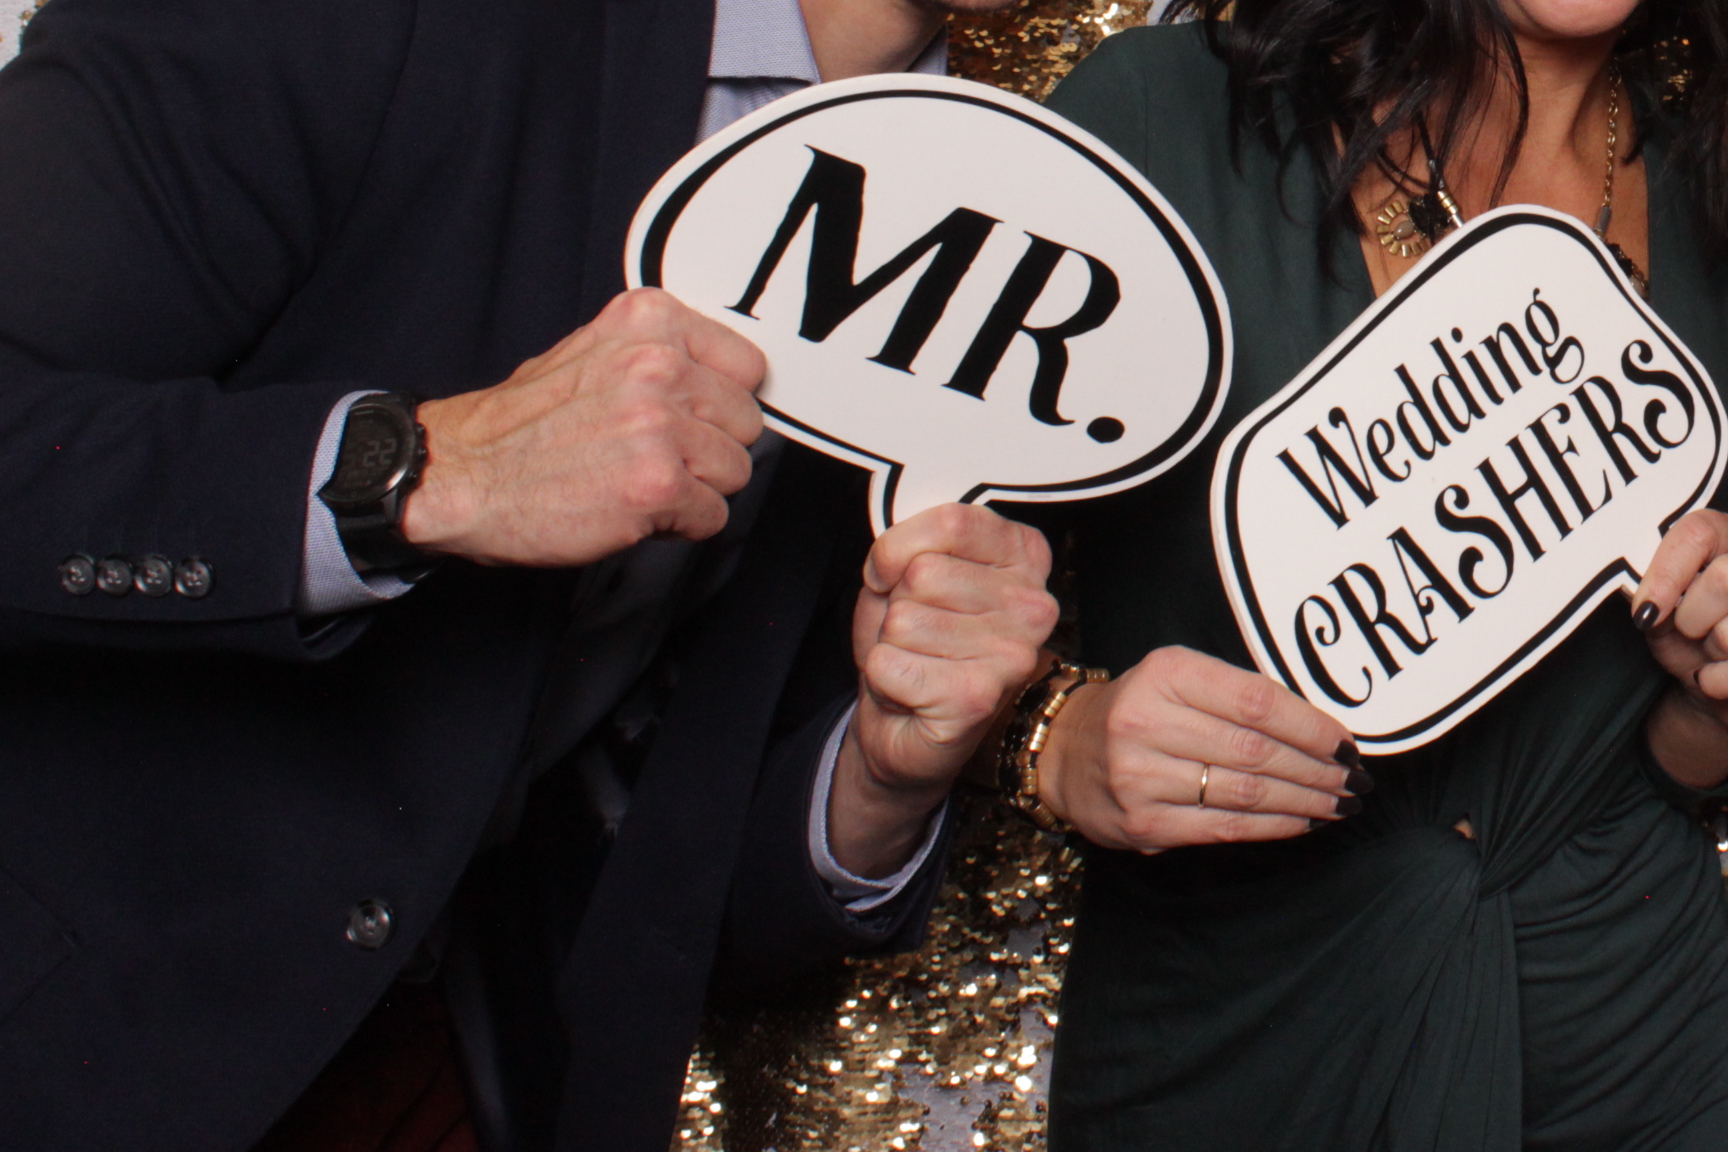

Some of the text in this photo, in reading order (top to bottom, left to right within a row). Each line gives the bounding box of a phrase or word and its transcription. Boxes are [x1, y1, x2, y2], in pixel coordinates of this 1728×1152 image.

[724, 144, 1125, 444] MR.
[1276, 288, 1584, 530] Wedding
[1294, 339, 1695, 708] CRASHERS
